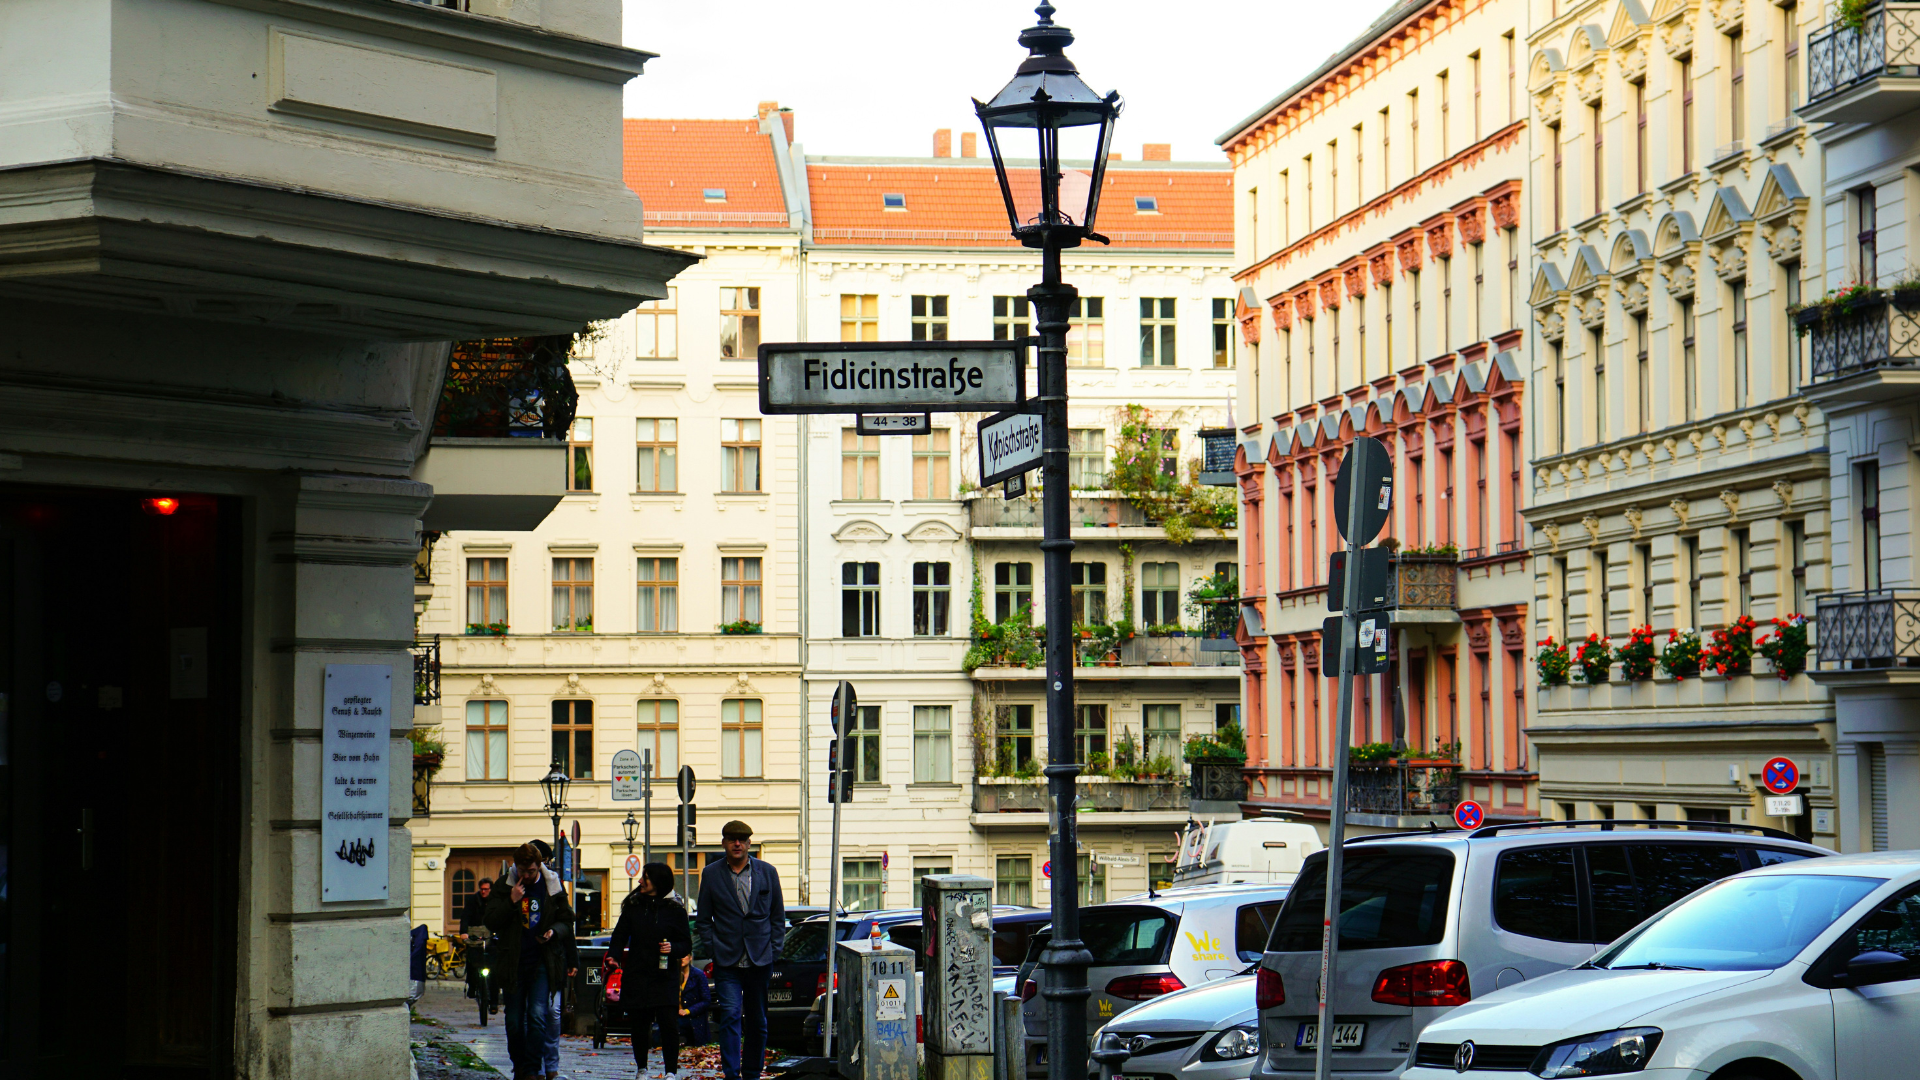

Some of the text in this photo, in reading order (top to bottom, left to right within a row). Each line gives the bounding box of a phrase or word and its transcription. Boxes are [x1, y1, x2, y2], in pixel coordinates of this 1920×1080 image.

[803, 357, 984, 396] Fidicinstraße
[873, 416, 888, 427] 44
[902, 416, 917, 427] 38
[343, 695, 372, 706] gepflegter
[353, 707, 359, 716] &
[332, 753, 347, 762] Bier
[349, 777, 355, 785] &
[1184, 930, 1221, 953] We
[1191, 952, 1230, 961] share.
[1098, 998, 1113, 1012] We
